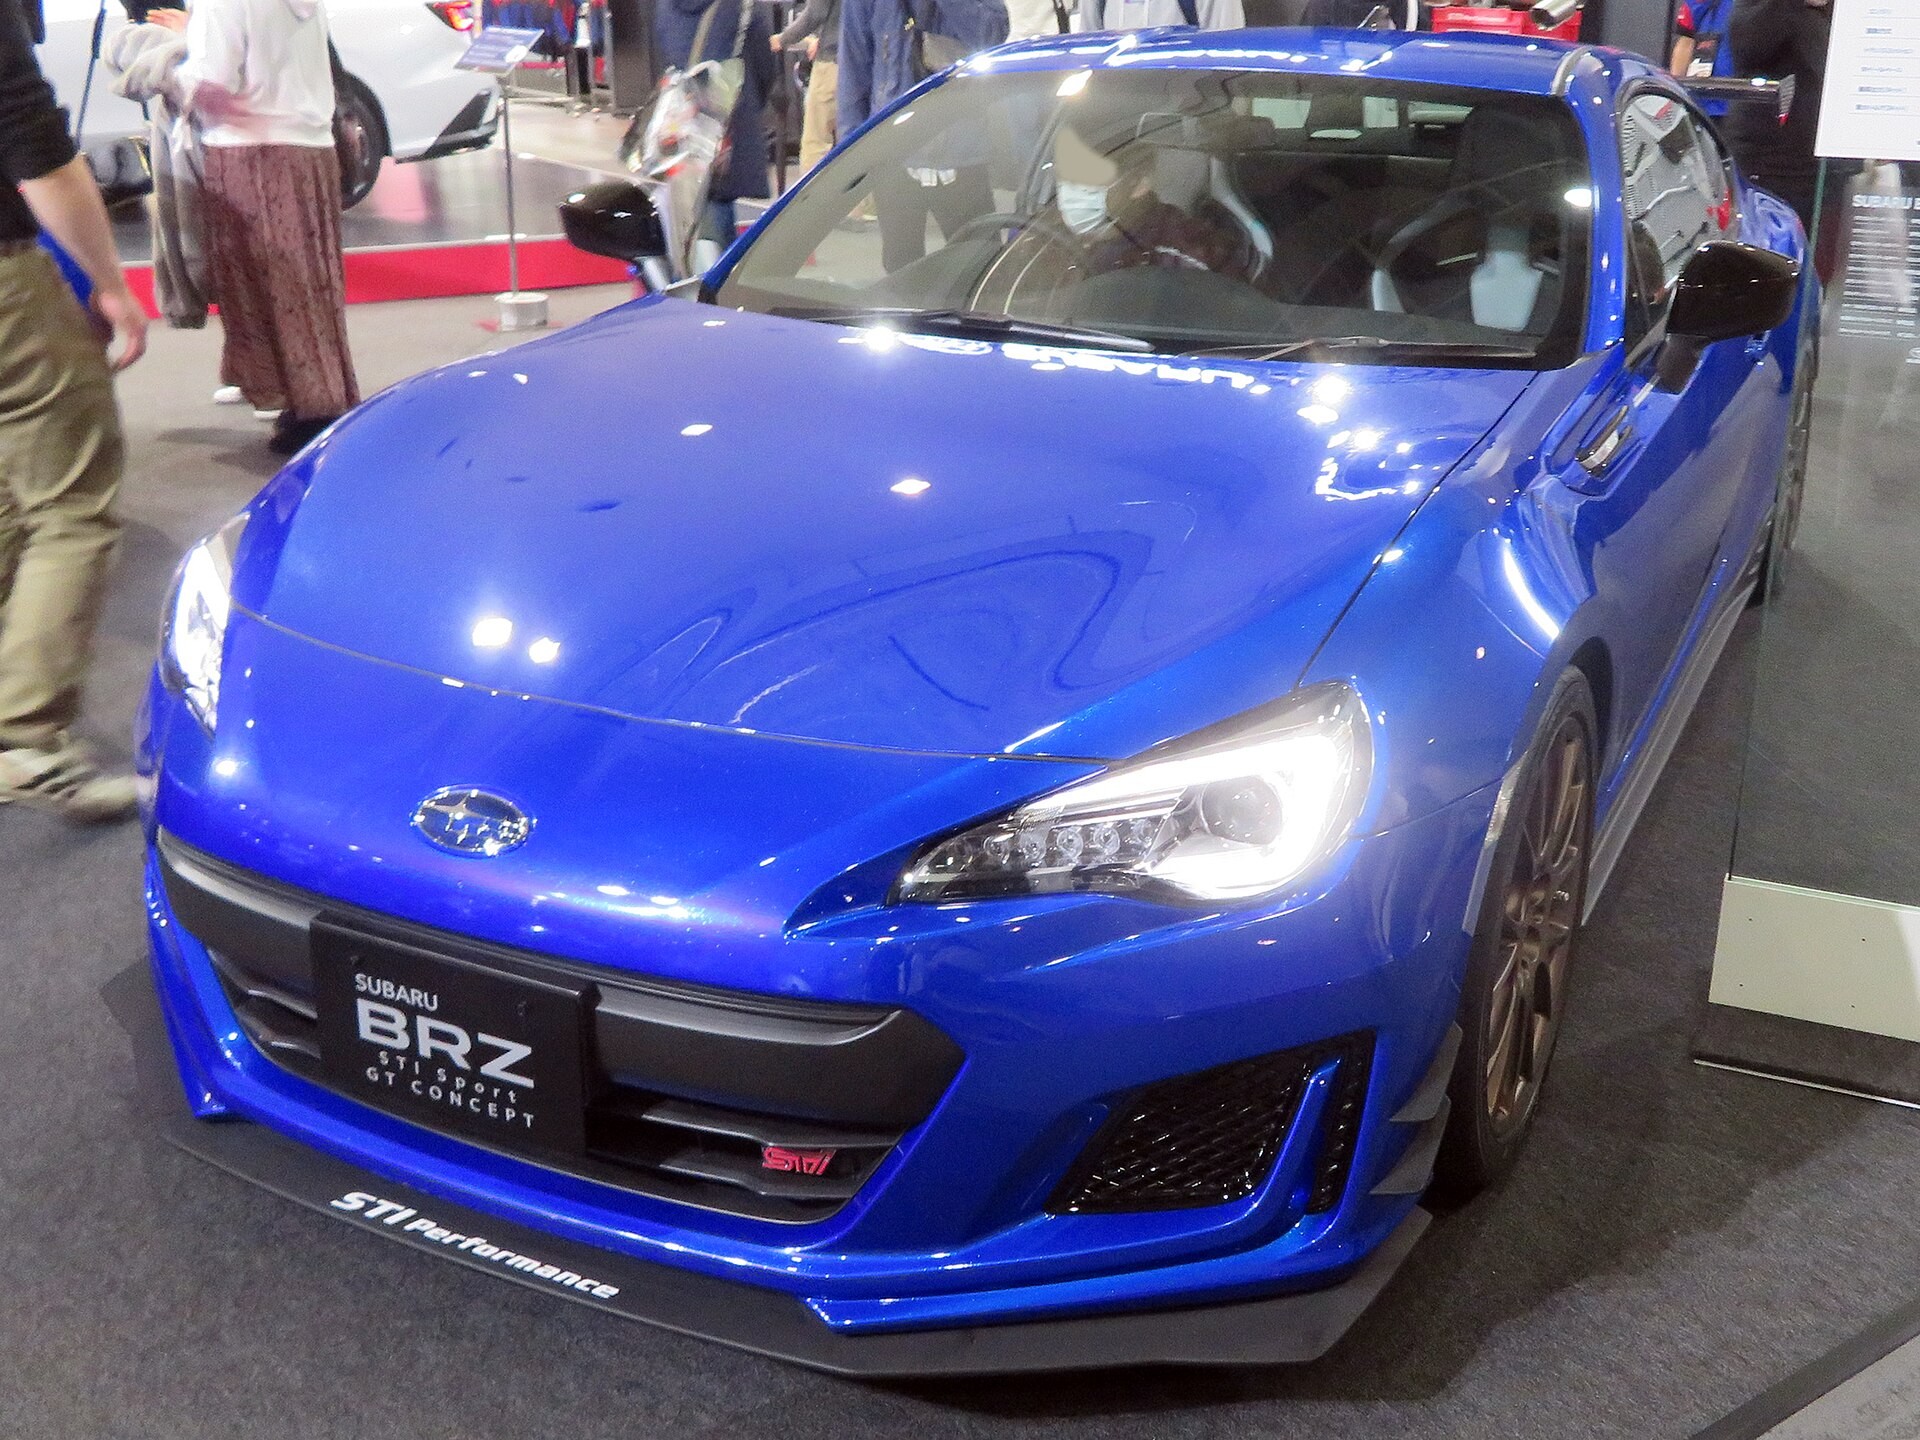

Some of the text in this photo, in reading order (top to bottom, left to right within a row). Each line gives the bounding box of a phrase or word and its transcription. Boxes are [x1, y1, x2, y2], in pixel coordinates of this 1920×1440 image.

[354, 973, 439, 1012] SUBARU
[357, 998, 535, 1089] BRZ
[366, 1066, 535, 1128] GT CONCEPT
[379, 1050, 517, 1104] STI Sport
[330, 1191, 621, 1299] STI Performance
